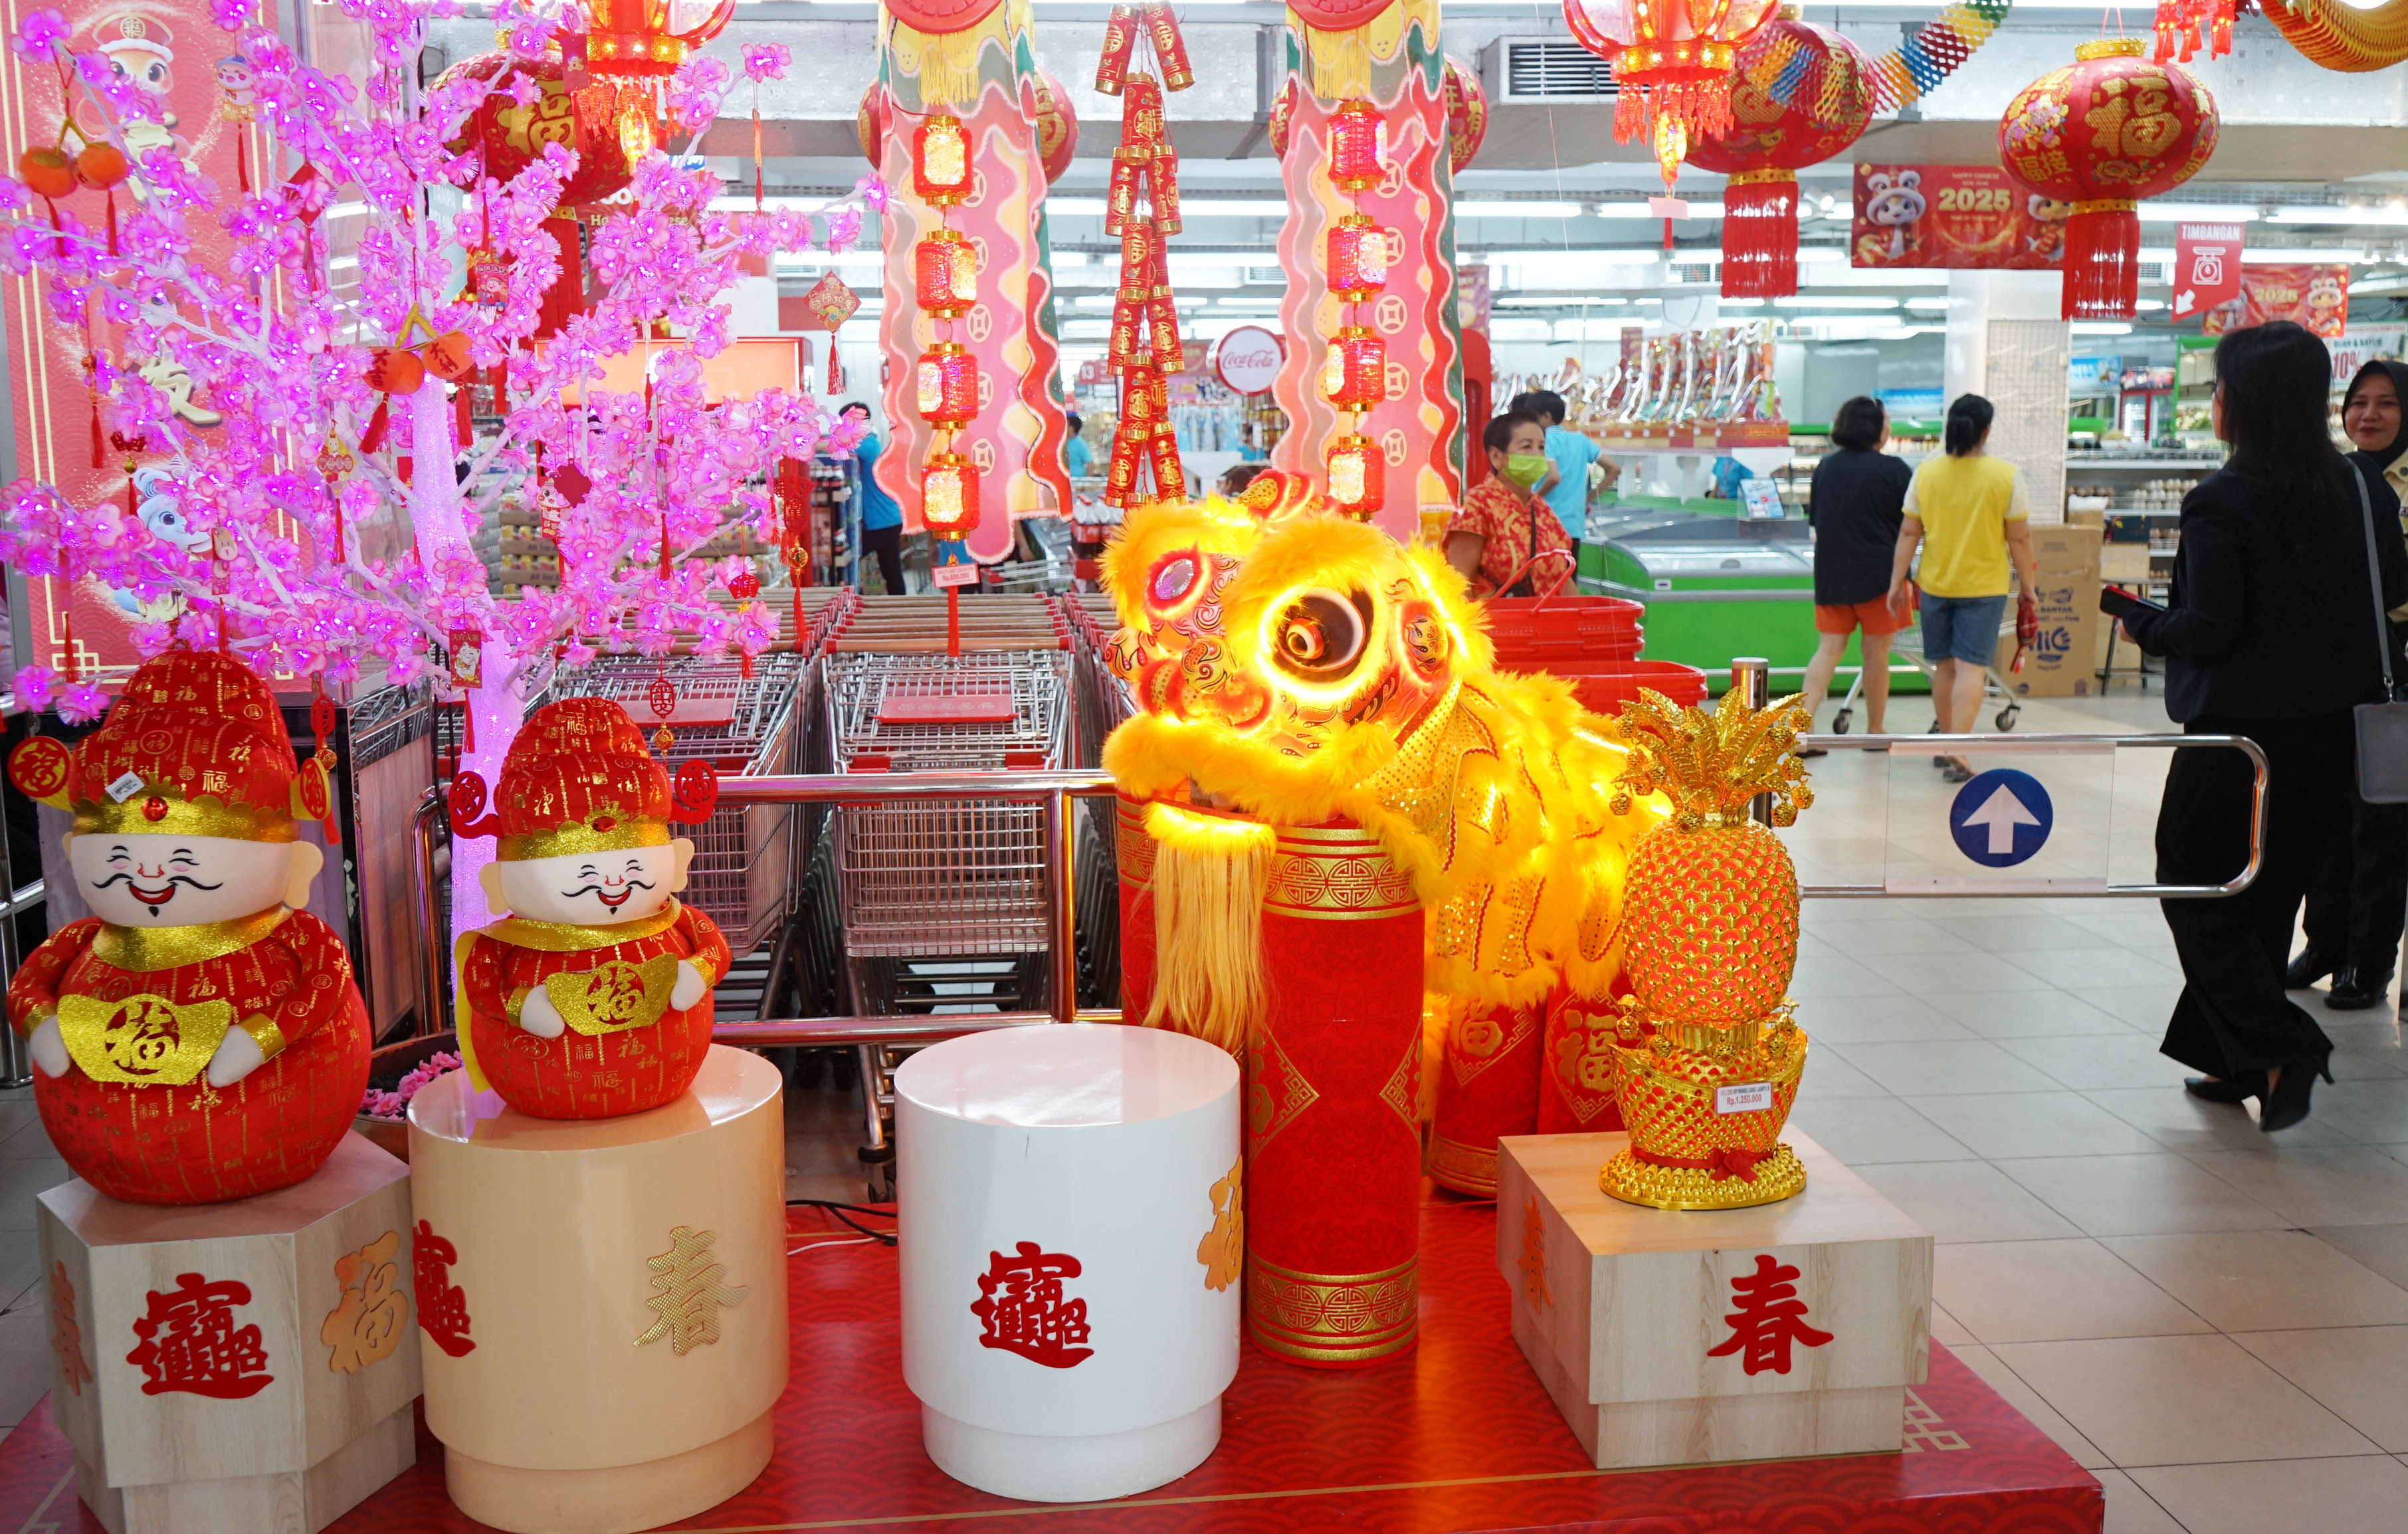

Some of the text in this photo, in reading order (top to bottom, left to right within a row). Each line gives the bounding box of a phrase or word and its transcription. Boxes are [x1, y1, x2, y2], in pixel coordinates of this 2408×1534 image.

[2084, 76, 2182, 157] 福
[1938, 187, 2011, 213] 2025
[2181, 224, 2241, 241] TIMBANGAN
[566, 711, 587, 736] 福
[1555, 1011, 1617, 1091] 福
[1727, 1093, 1762, 1107] Rp.1.250.000
[321, 1230, 409, 1374] 福
[632, 1225, 750, 1357] 春
[1706, 1254, 1834, 1376] 春
